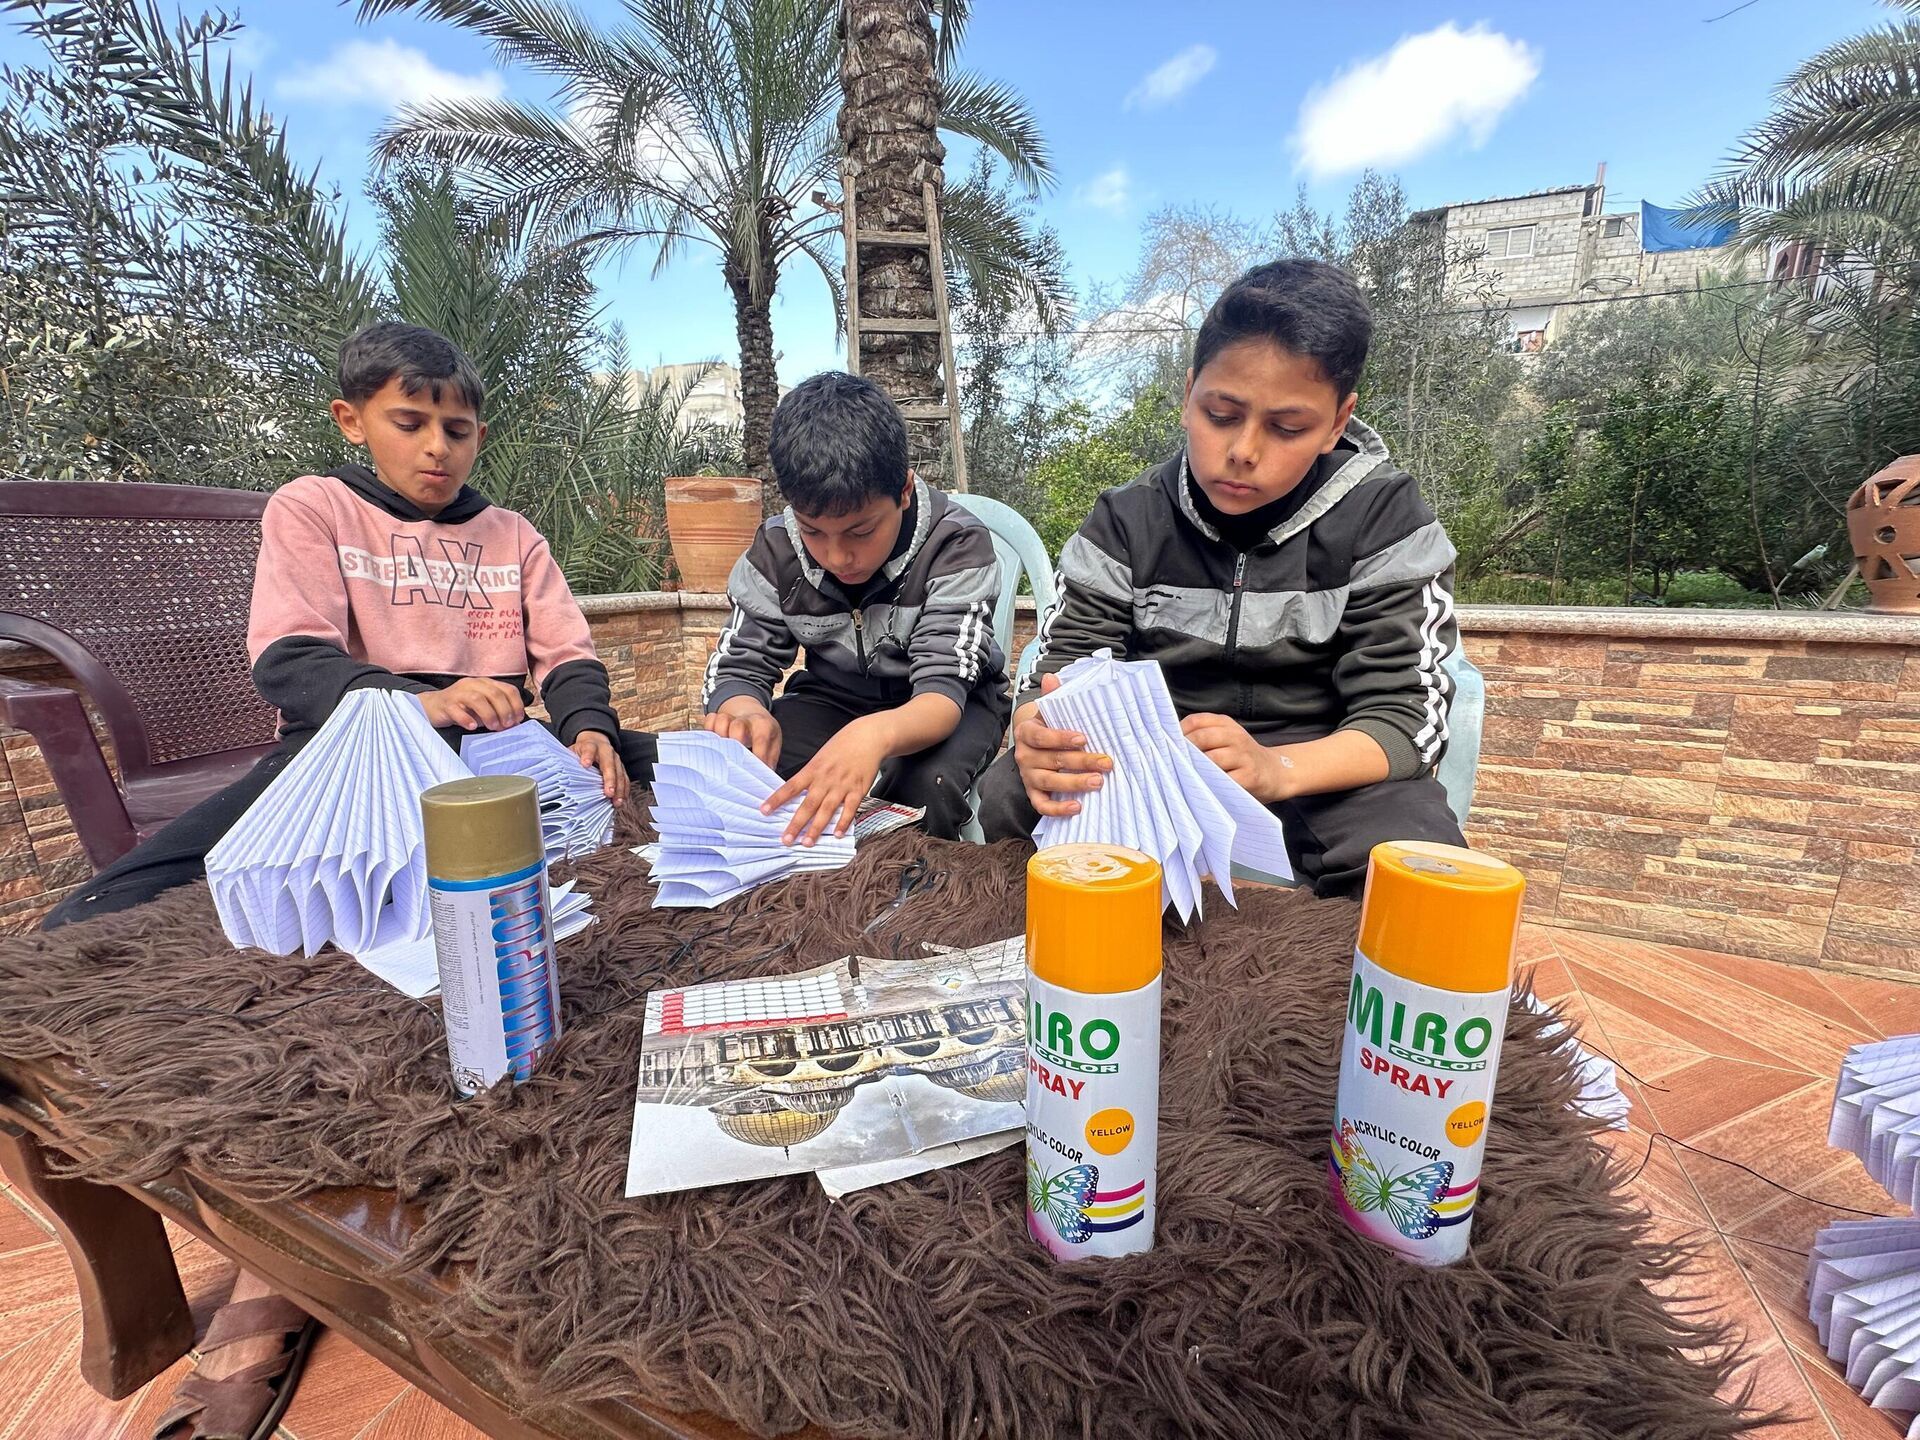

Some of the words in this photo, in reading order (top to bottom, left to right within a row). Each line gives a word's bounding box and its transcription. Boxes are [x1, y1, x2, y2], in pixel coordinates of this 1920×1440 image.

[344, 552, 420, 581] STREE
[391, 533, 494, 609] AX
[1348, 973, 1492, 1058] MIRO
[1026, 1050, 1085, 1100] PRAY
[1036, 1045, 1118, 1073] COLOR
[1360, 1047, 1454, 1099] SPRAY
[1389, 1045, 1485, 1070] COLOR
[1026, 1121, 1047, 1144] CRYLIC
[1049, 1137, 1083, 1164] COLOR
[1090, 1124, 1131, 1137] YELLOW
[1353, 1119, 1396, 1144] ACRYLIC
[1399, 1136, 1441, 1161] COLOR
[1451, 1117, 1485, 1129] YELLOW
